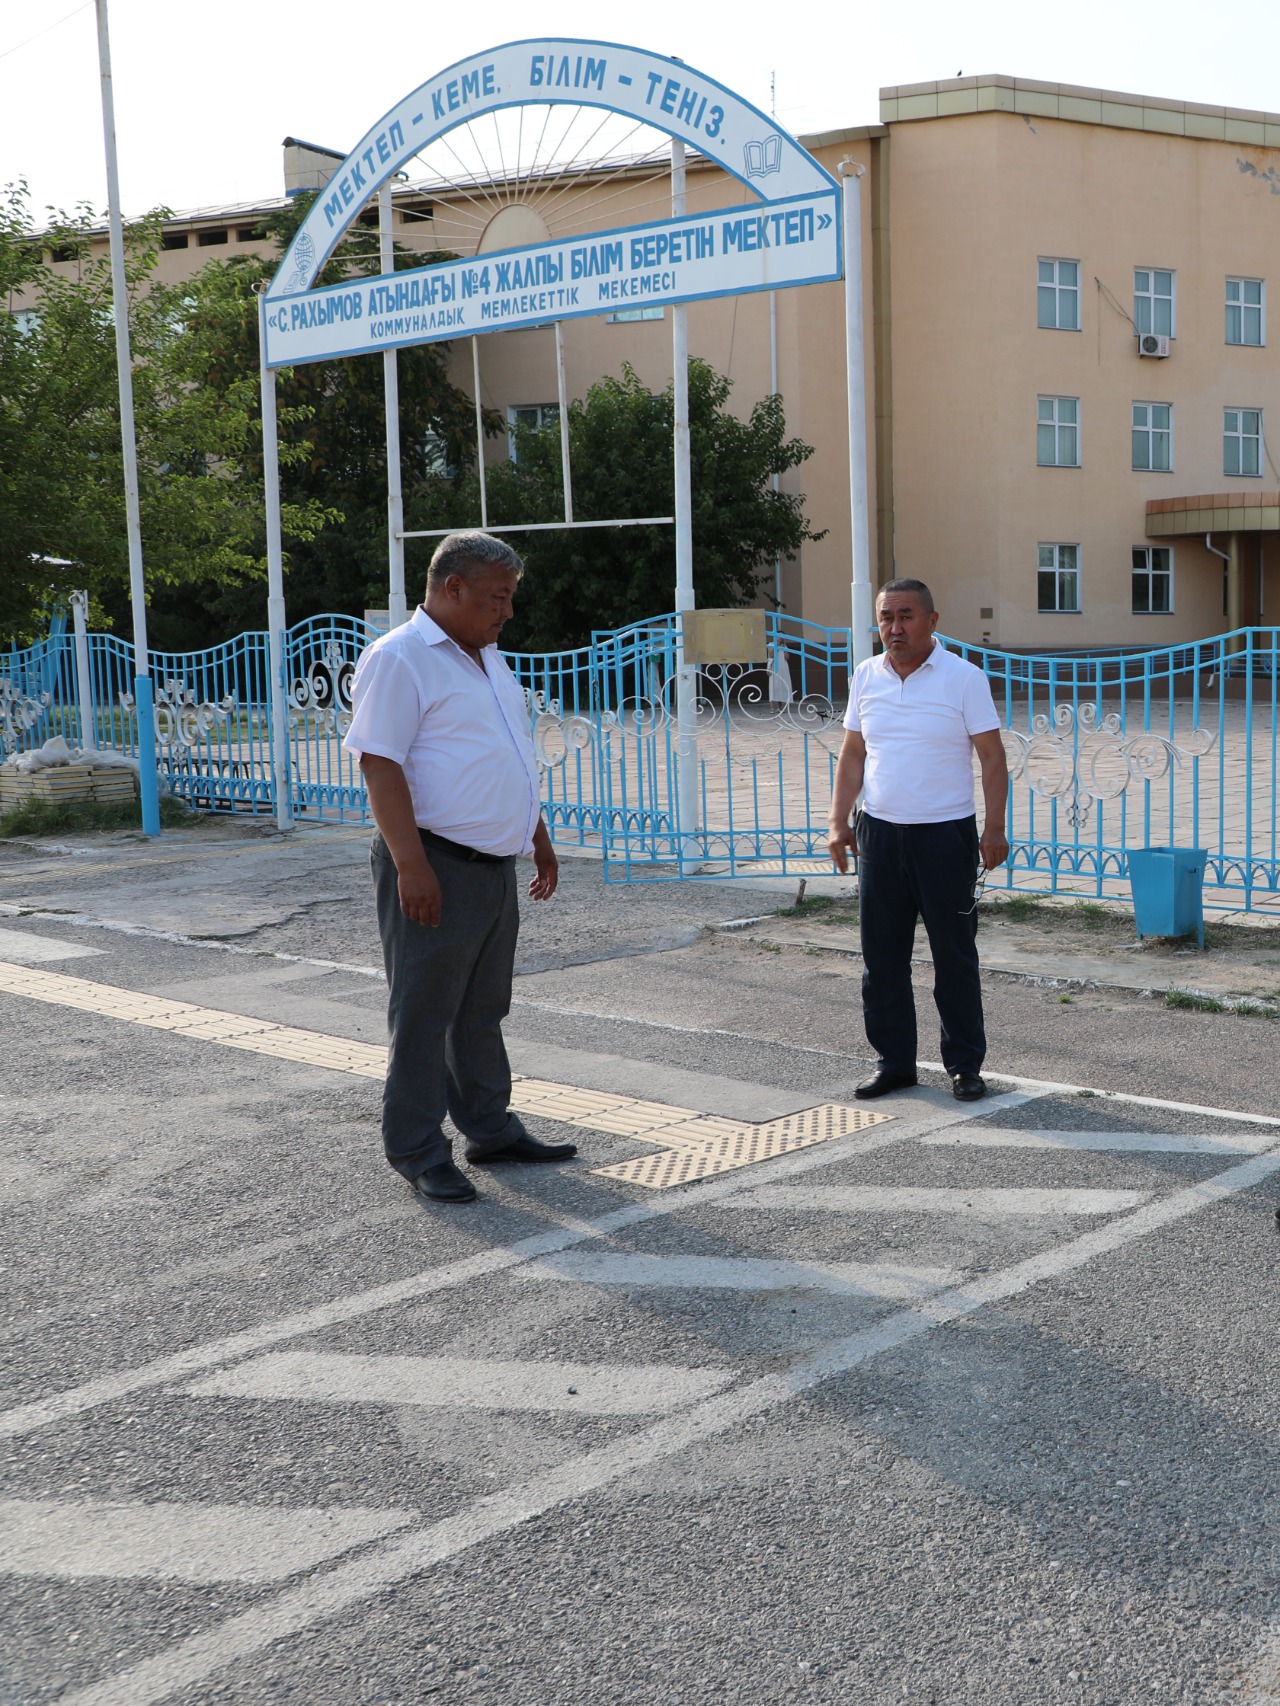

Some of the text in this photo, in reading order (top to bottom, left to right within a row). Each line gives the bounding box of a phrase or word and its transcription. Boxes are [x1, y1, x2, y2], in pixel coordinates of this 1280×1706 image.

[323, 119, 405, 228] МЕКТЕП
[529, 55, 607, 91] БІЛІМ
[367, 272, 456, 317] АТЫНДАҒЫ
[461, 265, 491, 299] №4
[495, 251, 564, 293] ЖАЛПЫ
[570, 240, 623, 281] БІЛІМ
[630, 224, 714, 270] БЕРЕТІН
[481, 286, 580, 320] МЕМЛЕКЕТТІК
[598, 271, 676, 301] МЕКЕМЕСІ
